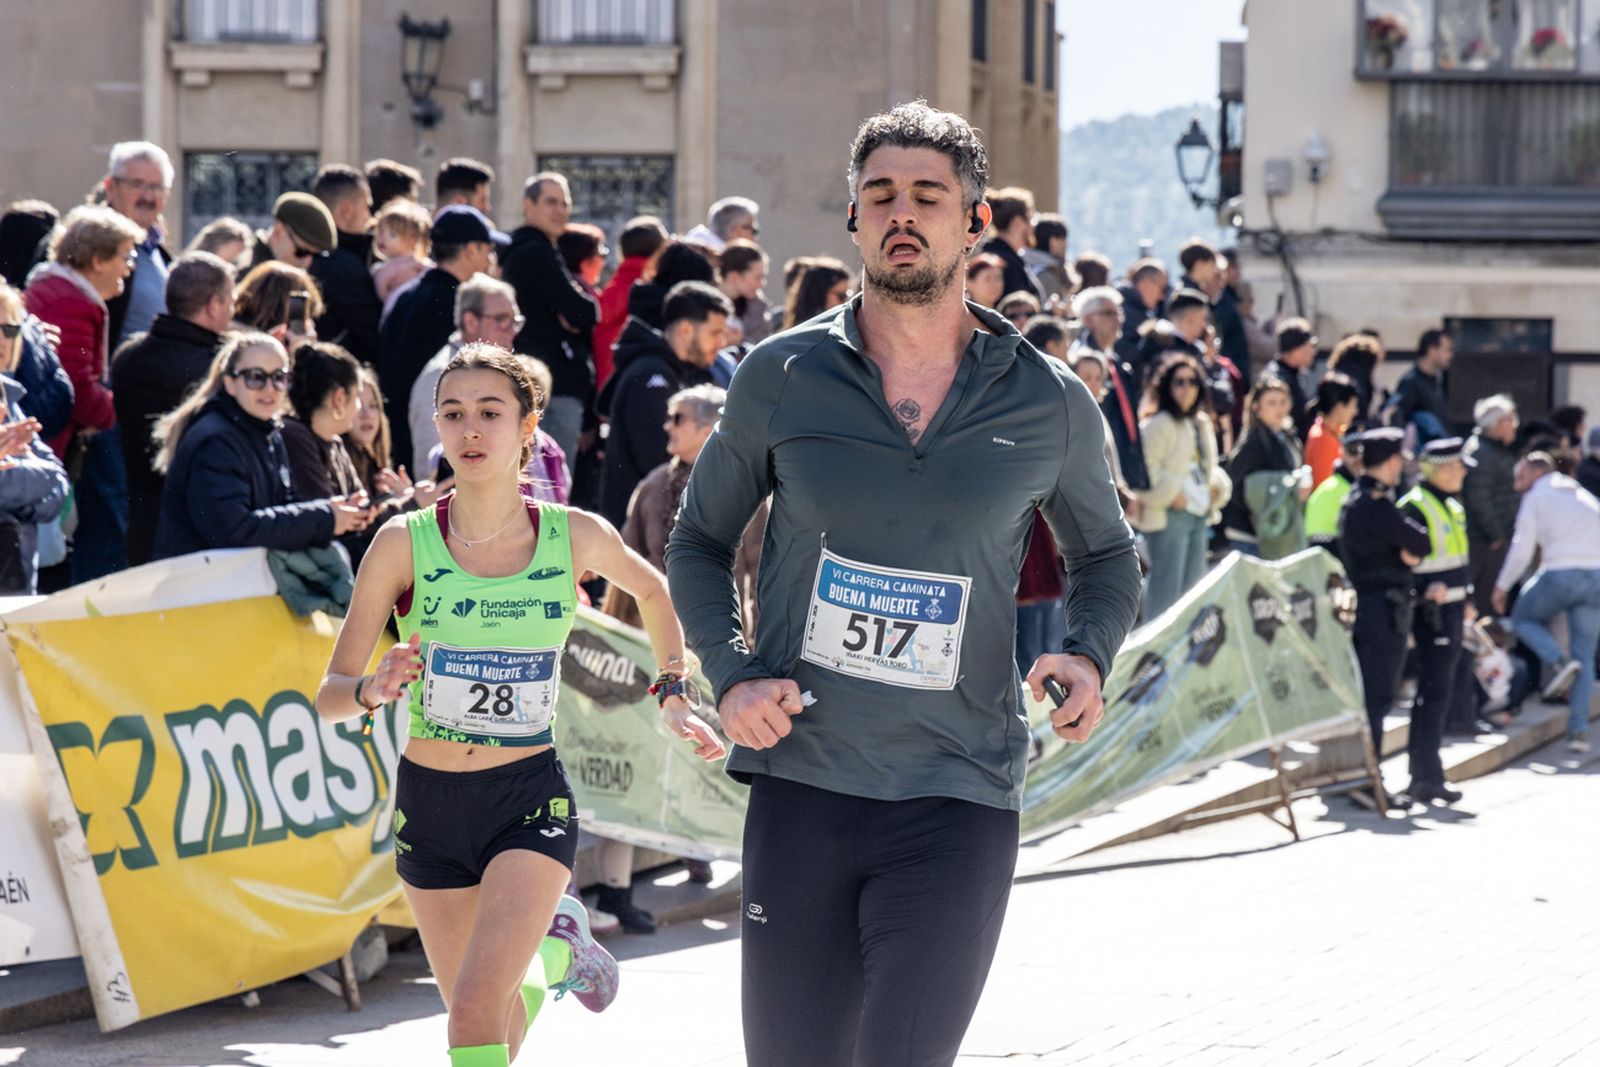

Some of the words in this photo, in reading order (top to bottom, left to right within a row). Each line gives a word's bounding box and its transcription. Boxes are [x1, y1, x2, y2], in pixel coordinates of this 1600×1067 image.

[832, 567, 841, 580] VI
[842, 571, 890, 591] CARRERA
[892, 581, 946, 597] CAMINATA
[480, 597, 542, 609] Fundación
[828, 583, 866, 608] BUENA
[869, 593, 920, 616] MUERTE
[480, 609, 526, 620] Unicaja
[842, 612, 919, 659] 517
[445, 662, 479, 678] BUENA
[482, 665, 522, 680] MUERTE
[458, 653, 499, 663] CARRERA
[501, 655, 544, 665] CAMINATA
[467, 683, 514, 717] 28
